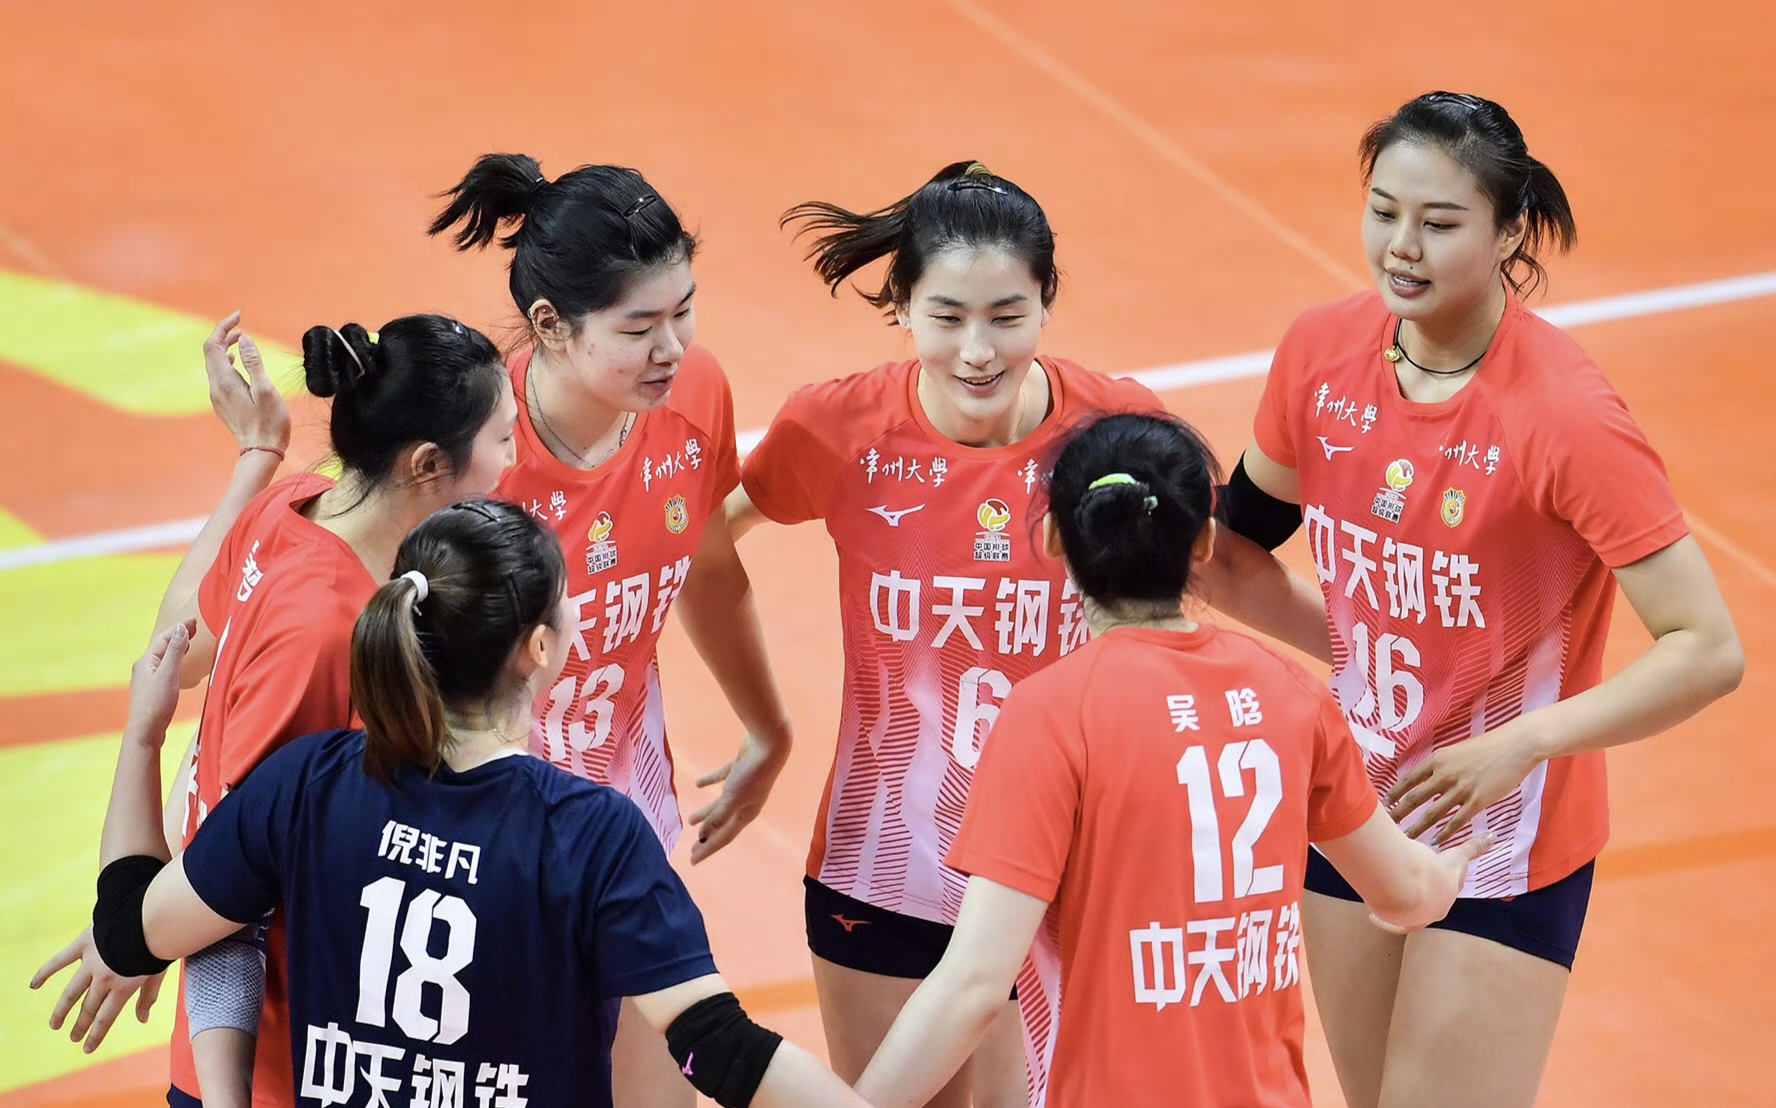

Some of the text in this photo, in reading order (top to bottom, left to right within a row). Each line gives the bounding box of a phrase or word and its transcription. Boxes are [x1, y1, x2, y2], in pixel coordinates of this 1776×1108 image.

[522, 490, 568, 521] 大學
[1017, 458, 1054, 495] 常
[1438, 439, 1500, 476] 州大學
[1304, 503, 1486, 629] 中天钢铁
[547, 662, 625, 762] 13
[952, 666, 1013, 769] 6
[1352, 621, 1424, 733] 16
[378, 819, 482, 885] 倪非凡
[1176, 738, 1284, 904] 12
[355, 876, 478, 1046] 18
[1129, 901, 1300, 1012] 中天钢铁
[300, 1021, 530, 1108] 中天钢铁
